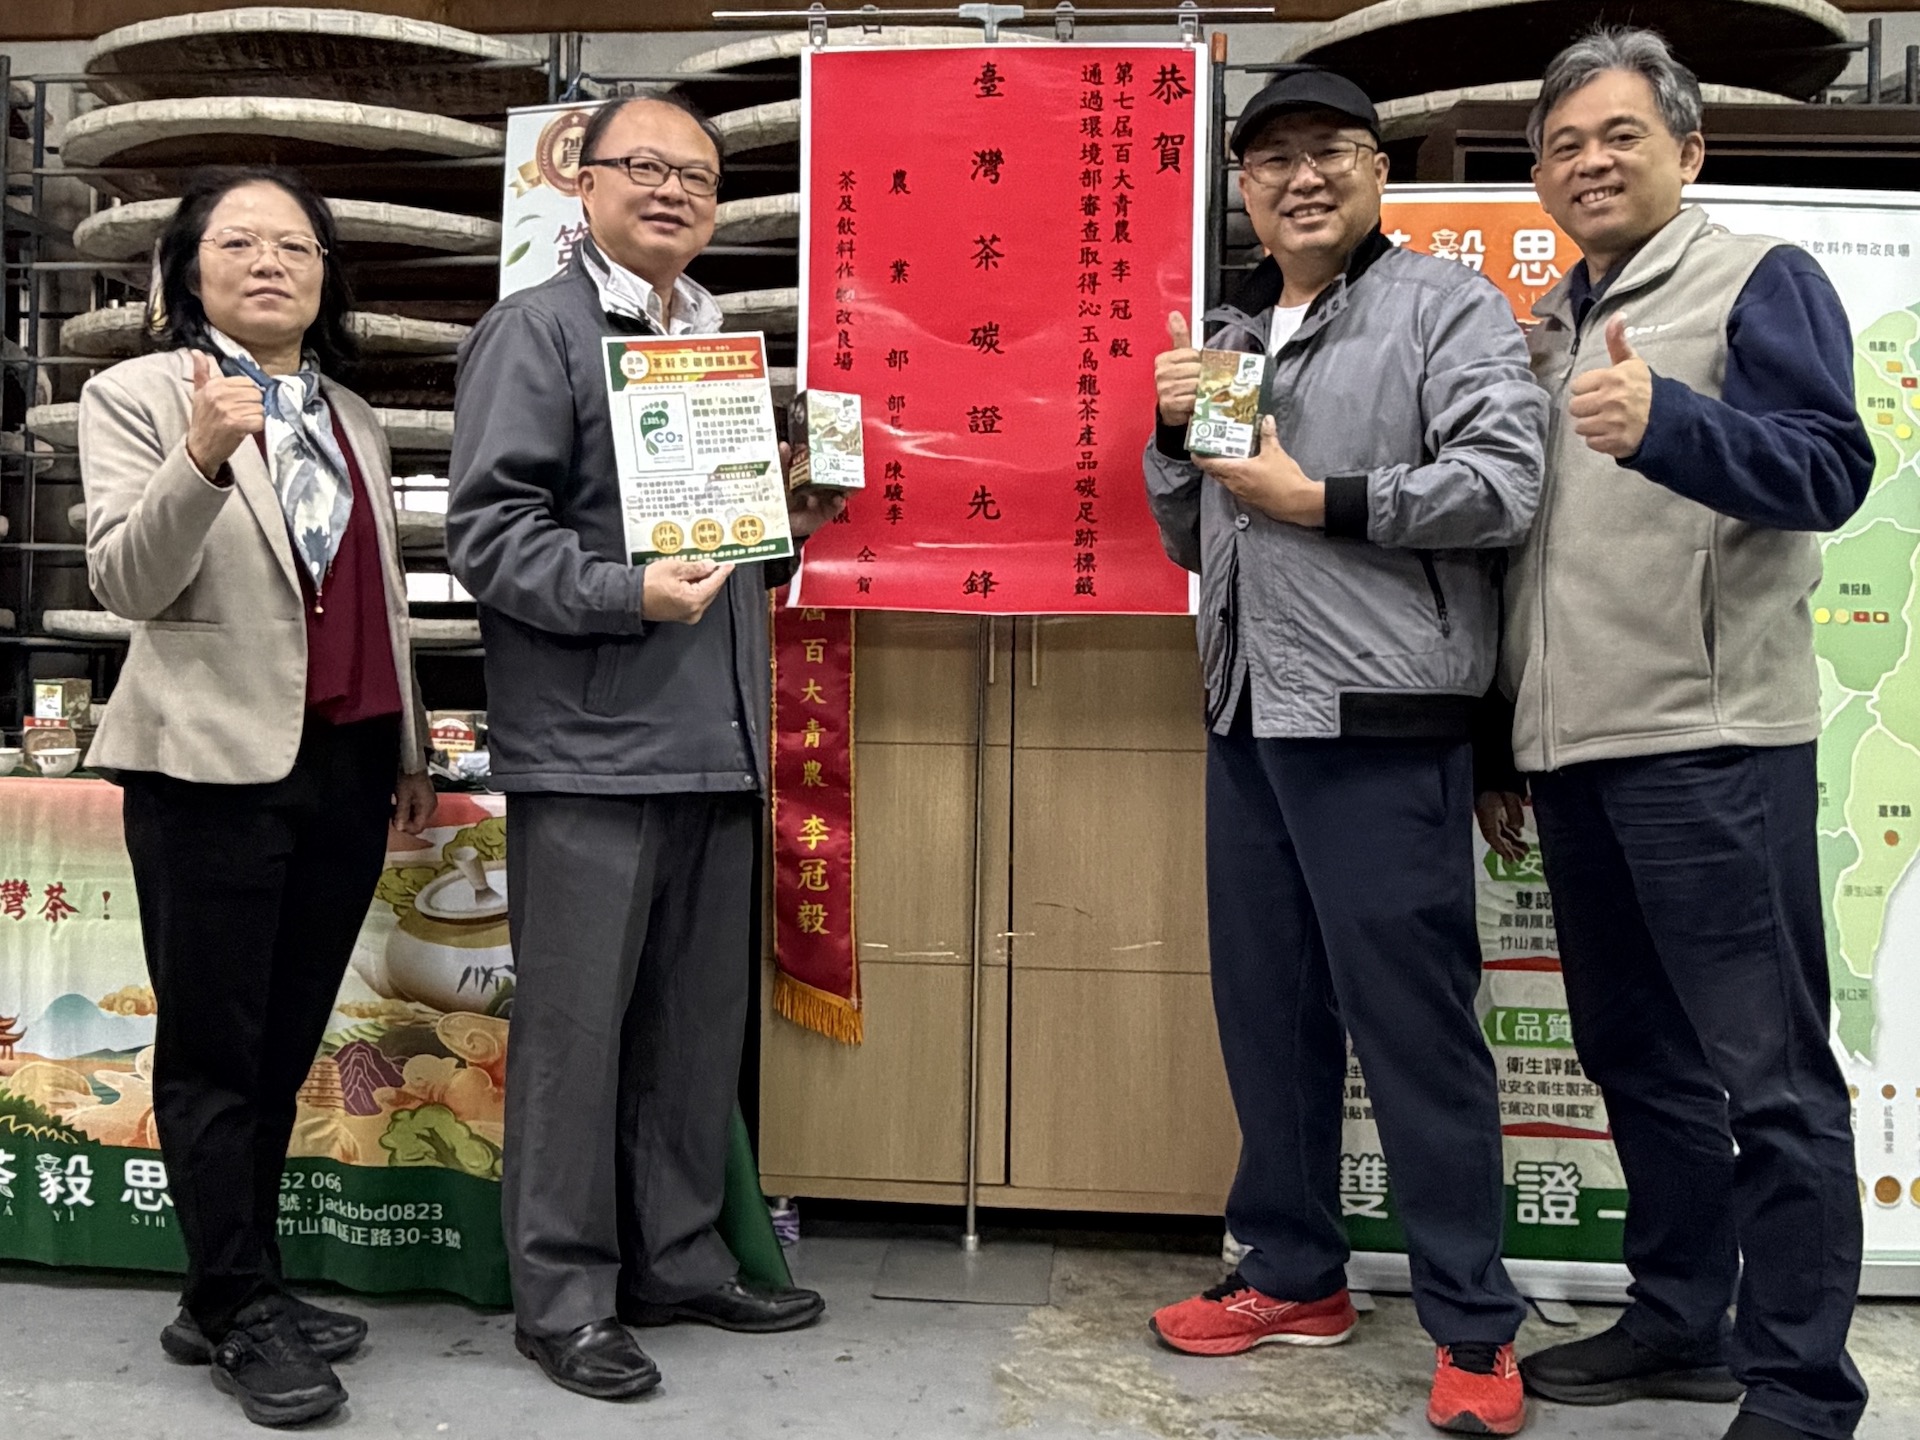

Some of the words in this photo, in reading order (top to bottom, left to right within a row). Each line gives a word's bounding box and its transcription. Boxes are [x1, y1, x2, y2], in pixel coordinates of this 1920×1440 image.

[1110, 62, 1135, 244] 第七屆百大青農
[1149, 63, 1192, 175] 恭賀
[796, 813, 831, 936] 李冠毅
